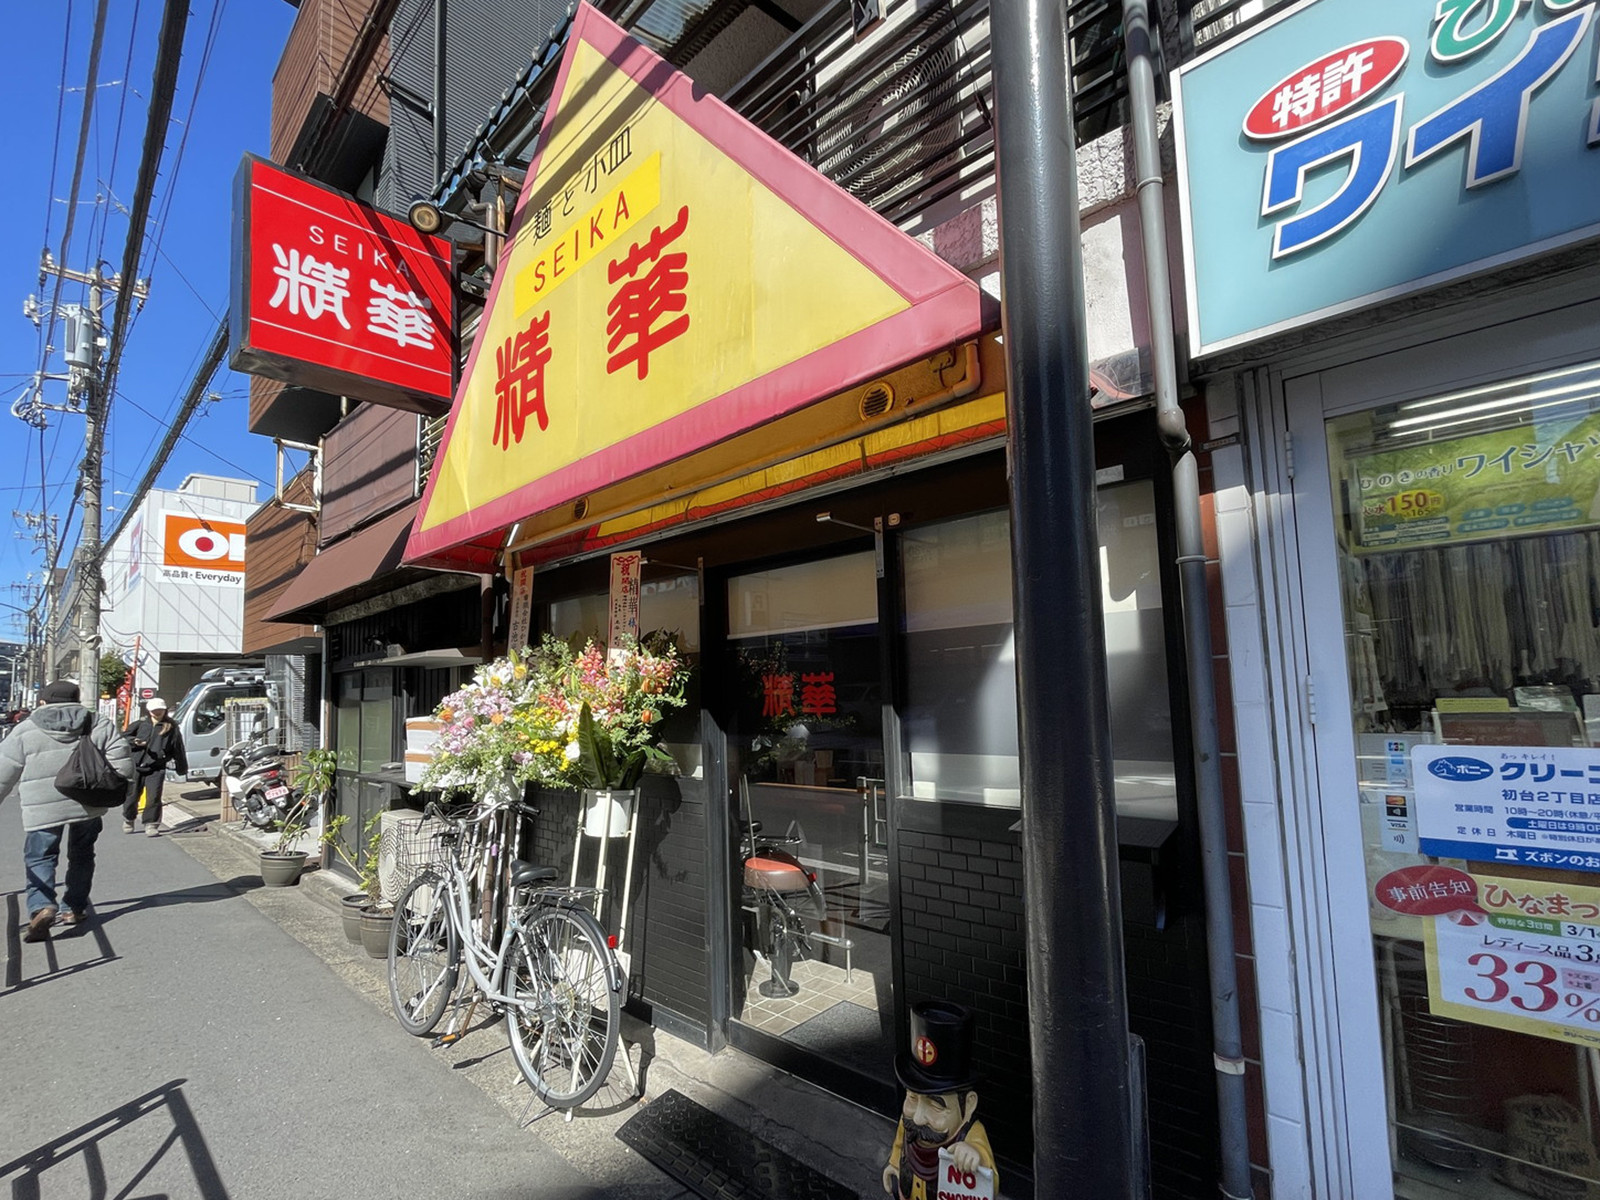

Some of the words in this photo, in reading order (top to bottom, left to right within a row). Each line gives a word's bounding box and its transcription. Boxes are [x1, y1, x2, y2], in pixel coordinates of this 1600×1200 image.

[1271, 47, 1375, 129] 特許
[1261, 3, 1600, 260] ワイ
[532, 126, 633, 247] 麺と小皿
[308, 225, 410, 278] SEIKA
[533, 190, 630, 293] SEIKA
[269, 243, 435, 351] 精華
[492, 205, 690, 452] 精華
[762, 671, 837, 721] 精華
[1387, 879, 1471, 903] 事前告知
[1484, 883, 1600, 919] ひなまつ
[1484, 935, 1600, 964] レディース品3
[1464, 953, 1600, 1023] 33%
[947, 1164, 977, 1190] NO
